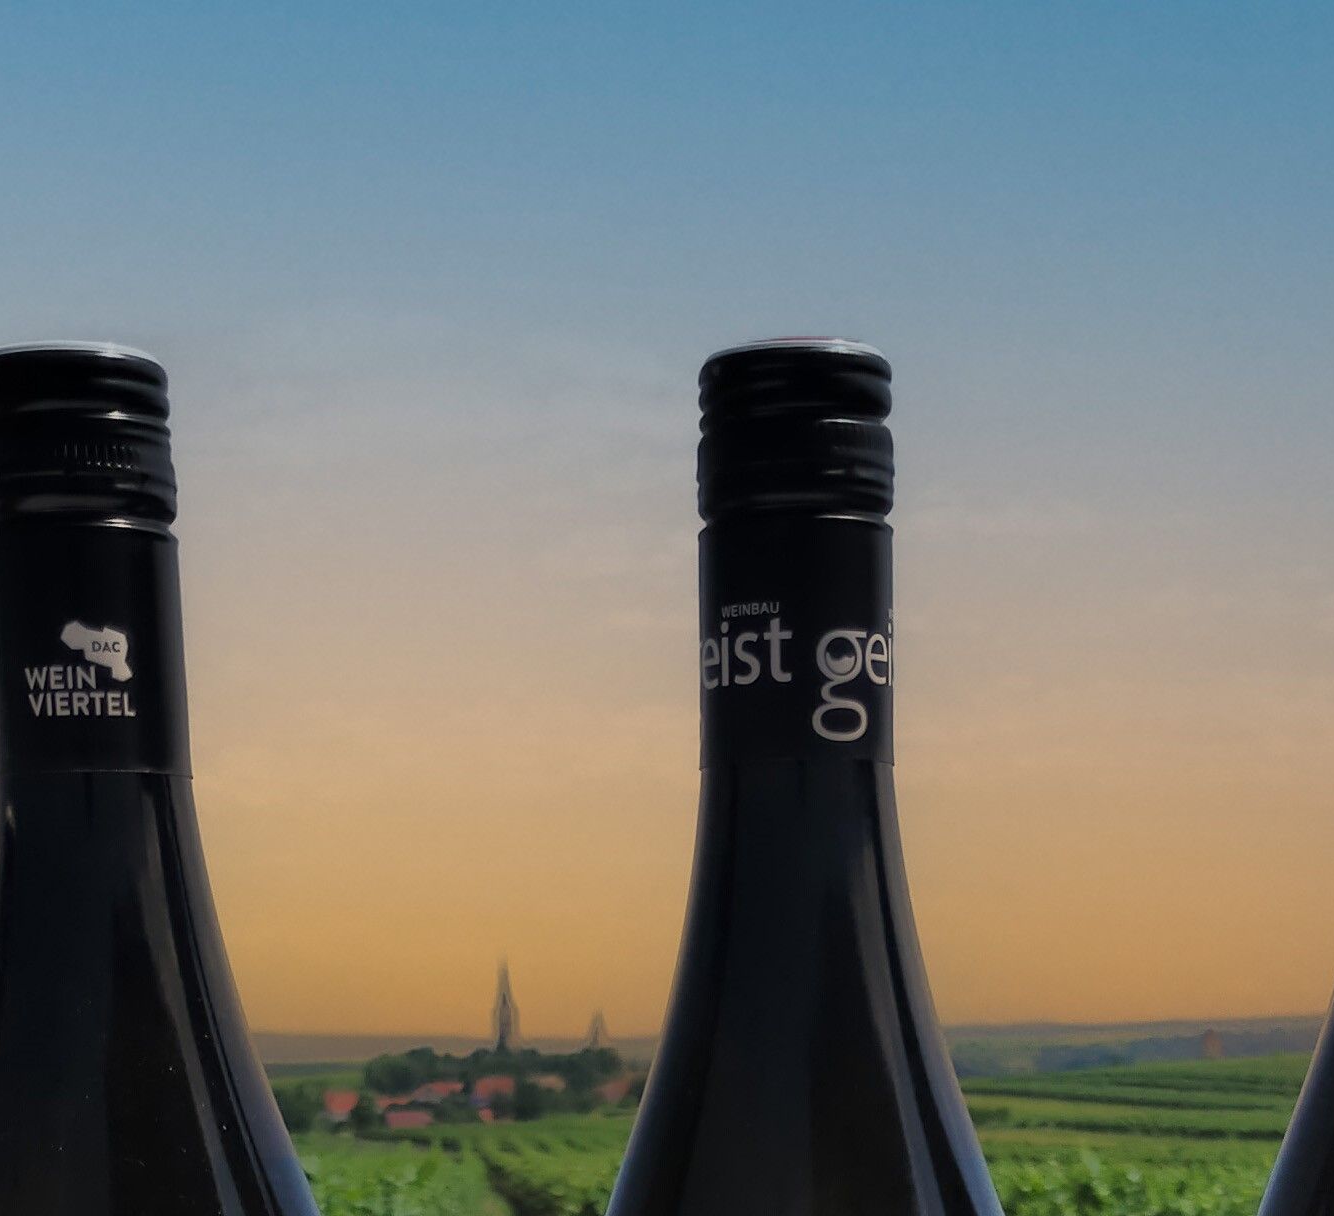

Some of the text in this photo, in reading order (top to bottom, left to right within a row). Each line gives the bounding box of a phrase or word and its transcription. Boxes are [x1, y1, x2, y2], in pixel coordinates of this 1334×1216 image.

[721, 601, 780, 618] WEINBAU
[91, 640, 121, 654] DAC
[25, 664, 96, 691] WEIN
[29, 691, 137, 718] VIERTEL
